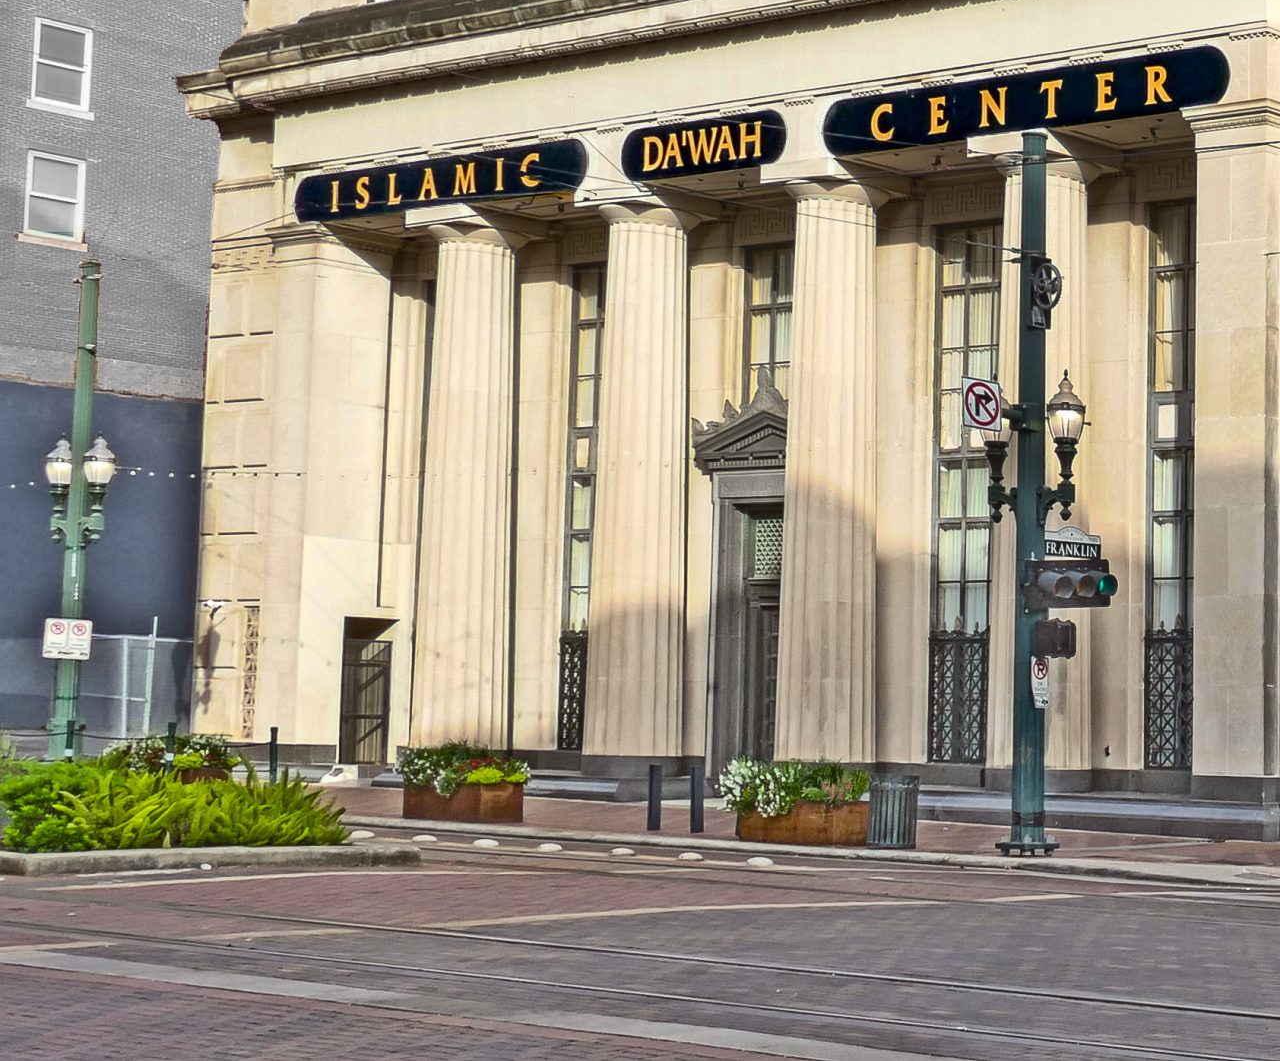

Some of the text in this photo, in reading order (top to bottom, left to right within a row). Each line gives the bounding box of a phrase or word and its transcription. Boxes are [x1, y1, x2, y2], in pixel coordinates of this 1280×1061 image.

[330, 65, 1173, 213] ISLAMIC DA'WAH CENTER
[1046, 541, 1098, 558] FRANKLIN
